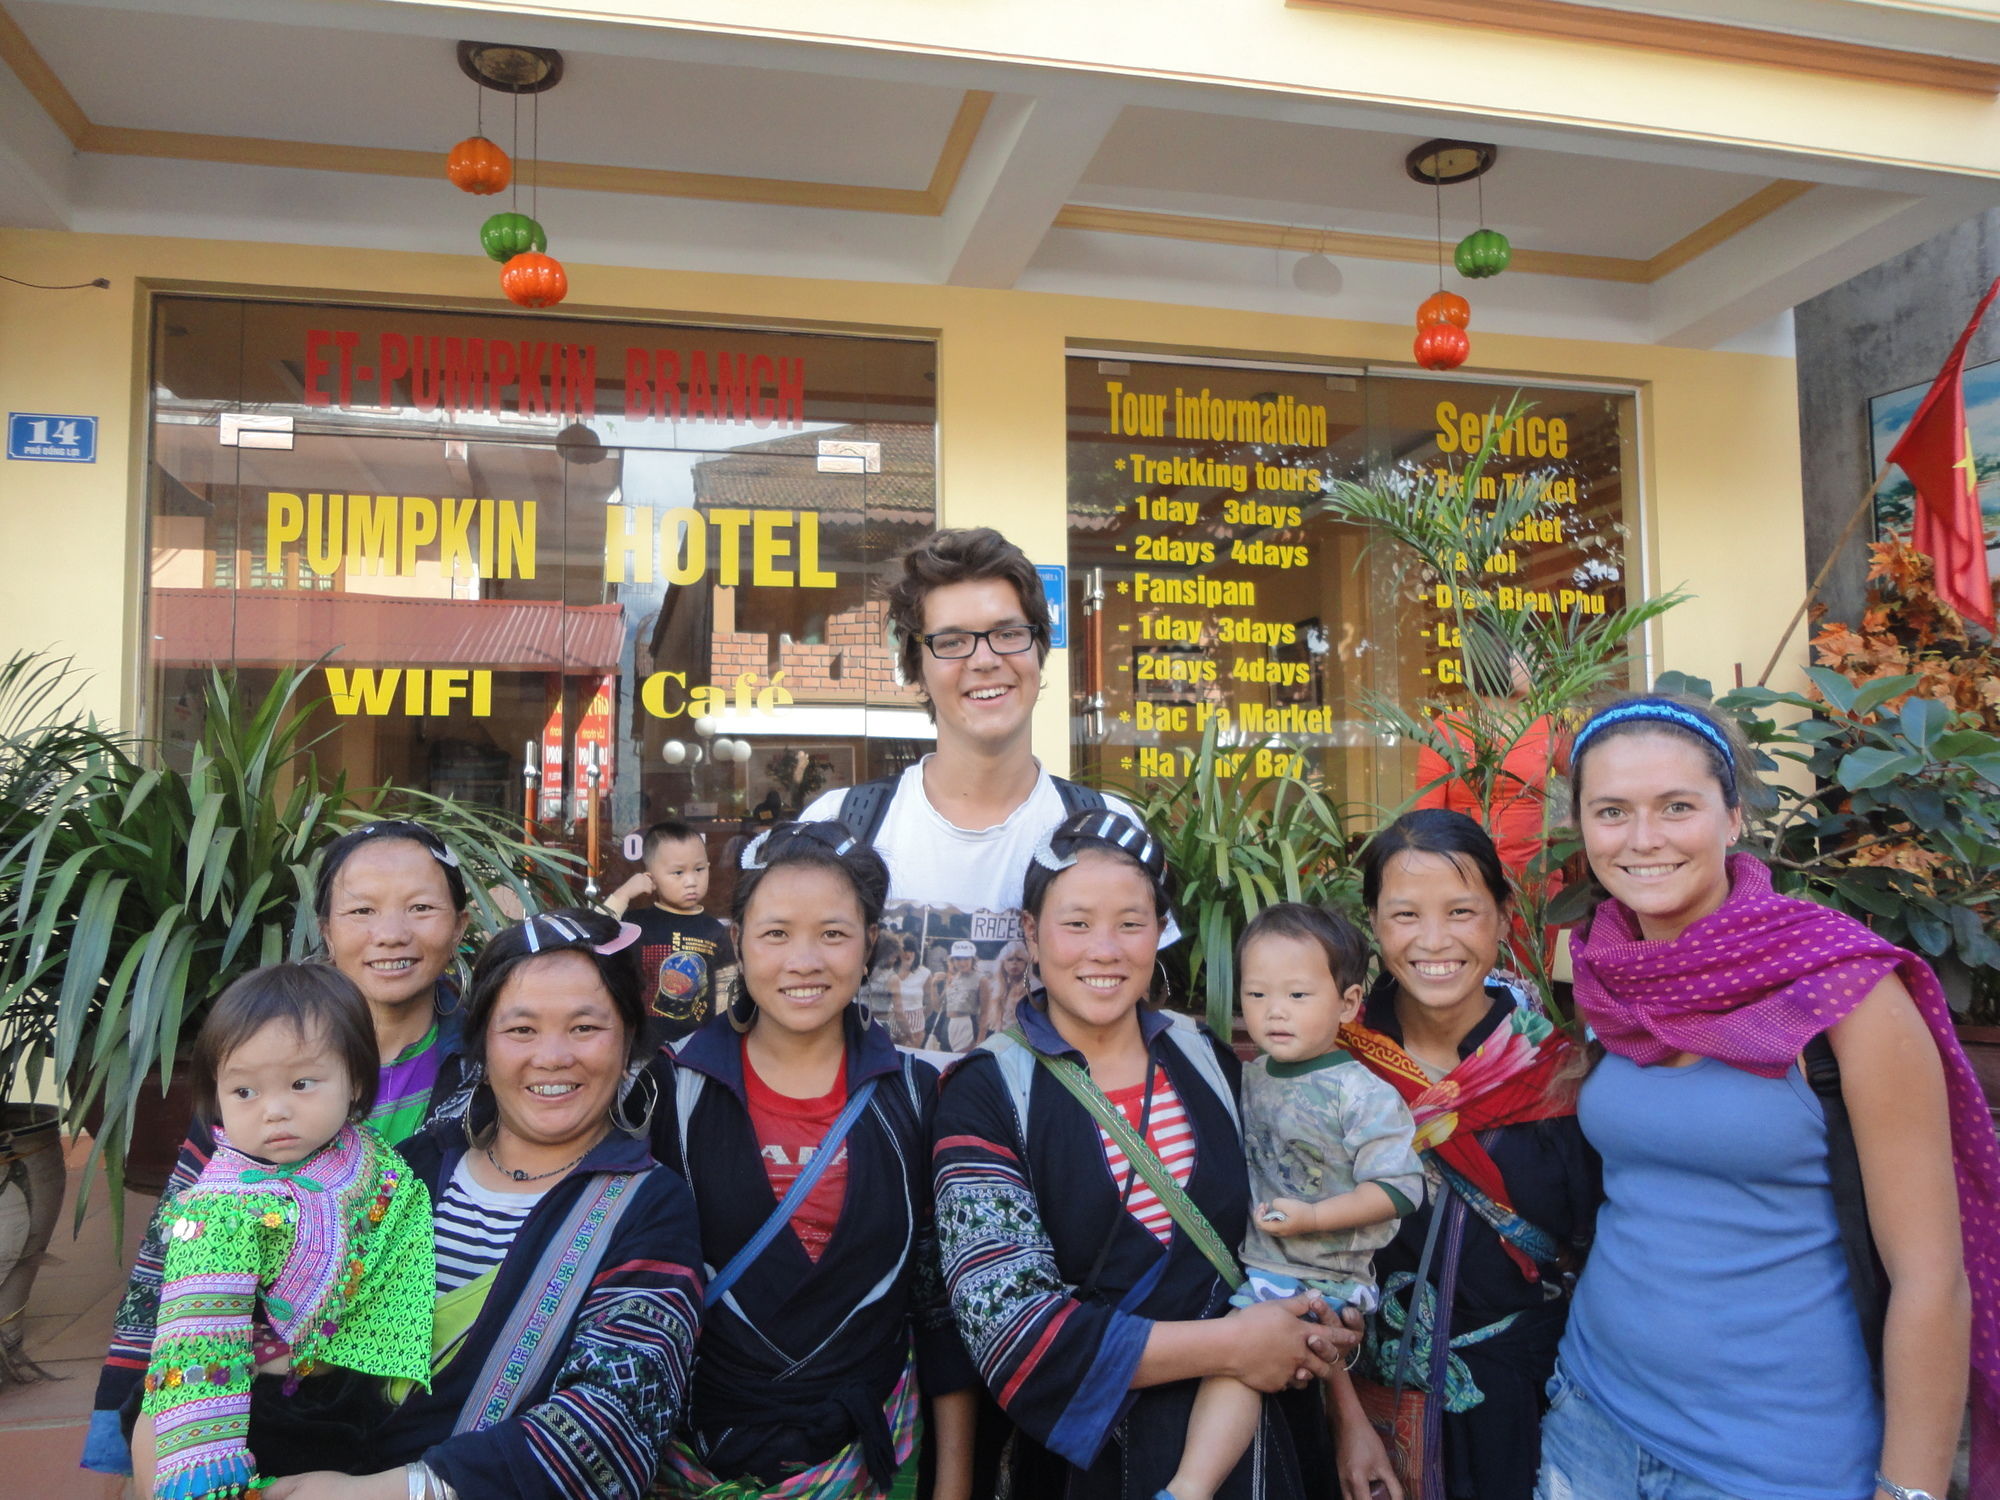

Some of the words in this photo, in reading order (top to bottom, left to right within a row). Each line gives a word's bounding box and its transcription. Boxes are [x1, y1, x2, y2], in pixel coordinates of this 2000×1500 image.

[304, 329, 596, 419] ET-PUMPKIN
[624, 346, 805, 431] BRANCH
[1106, 381, 1168, 438] Tour
[1175, 387, 1328, 448] information
[1436, 400, 1569, 459] Service
[27, 420, 81, 446] 14
[1129, 454, 1248, 493] Trekking
[1254, 461, 1322, 492] tours
[1501, 472, 1578, 505] Tiket
[1135, 495, 1200, 526] 1day
[1223, 499, 1302, 528] 3days
[266, 491, 537, 580] PUMPKIN
[606, 505, 838, 589] HOTEL
[1134, 535, 1216, 566] 2days
[1230, 539, 1309, 569] 4days
[1134, 572, 1256, 608] Fansipan
[1498, 586, 1554, 613] Bien
[1559, 588, 1606, 614] Phu
[1138, 614, 1205, 644] 1day
[1217, 616, 1297, 646] 3days
[1137, 655, 1218, 684] 2days
[1232, 656, 1311, 687] 4days
[324, 667, 492, 717] WIFI
[641, 669, 795, 719] Café
[1135, 701, 1188, 733] Bac
[1196, 702, 1231, 733] Ha
[1238, 702, 1334, 734] Market
[1139, 746, 1177, 778] Ha
[1183, 750, 1248, 783] Lng
[1255, 748, 1306, 781] Bay
